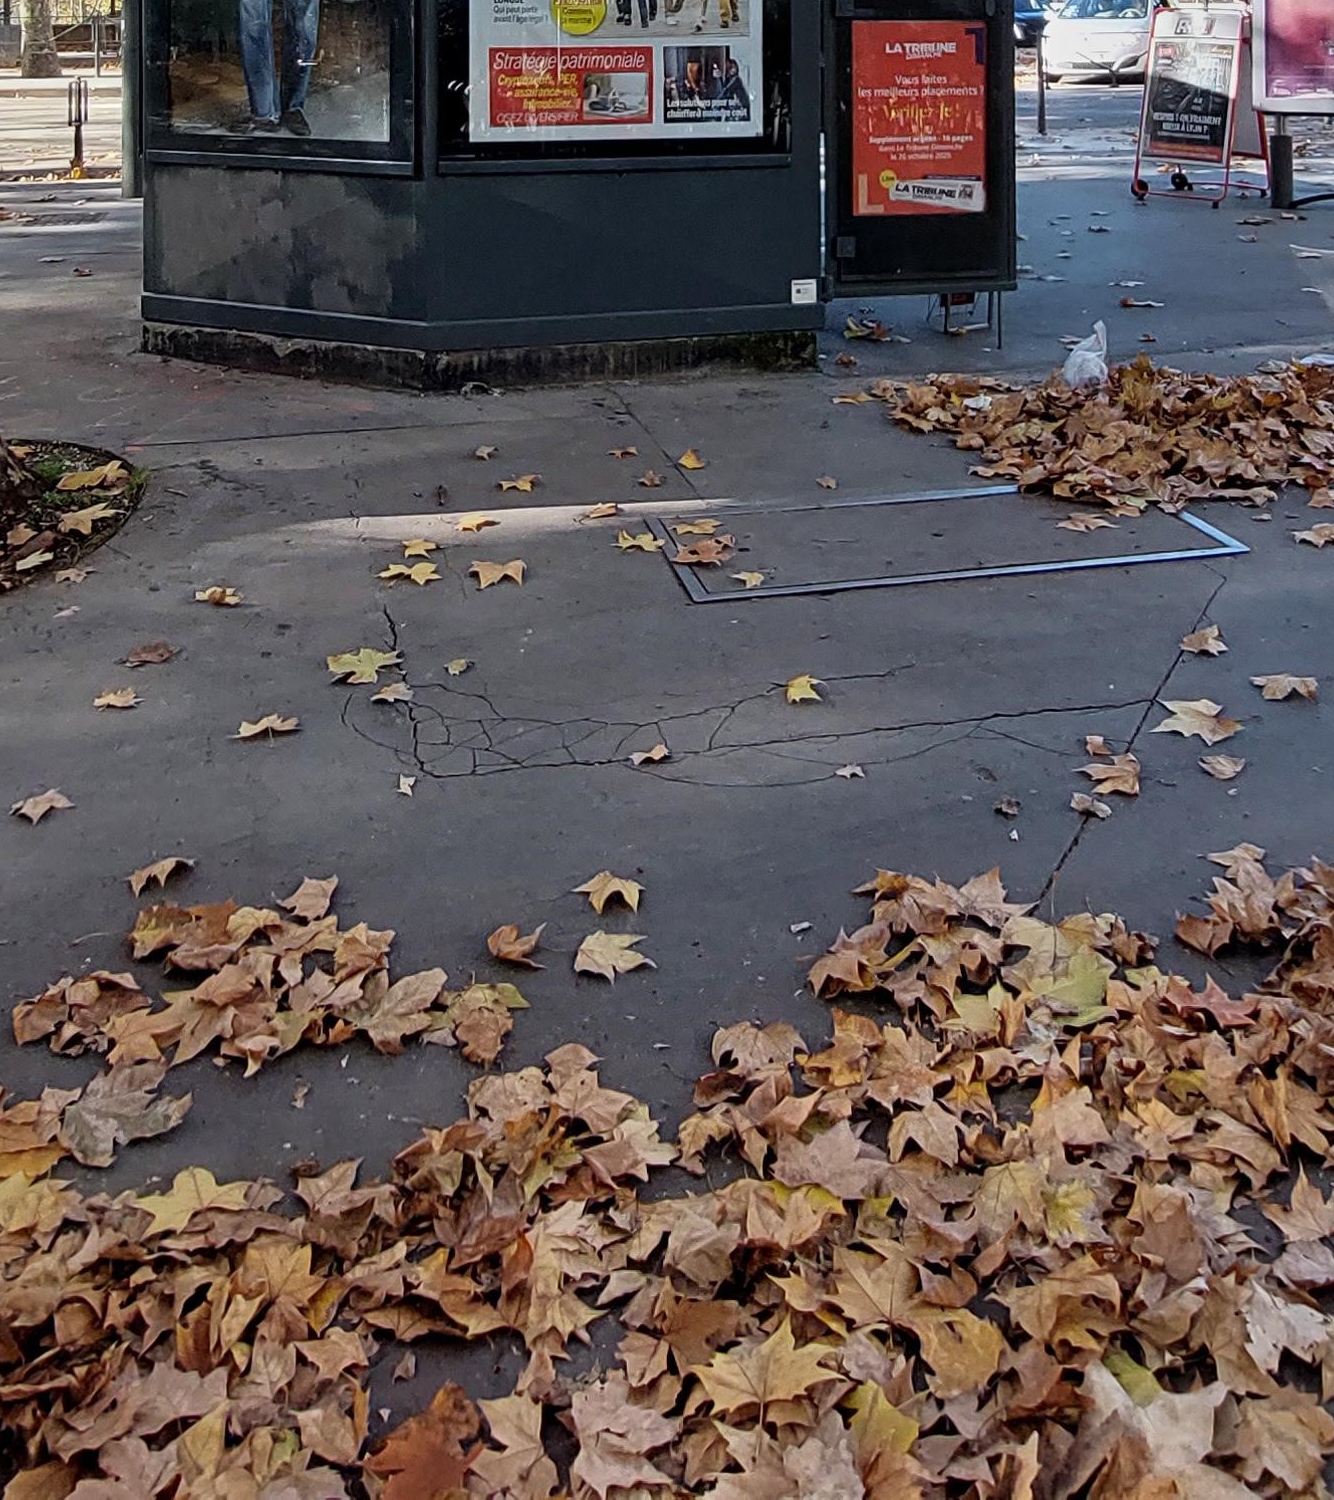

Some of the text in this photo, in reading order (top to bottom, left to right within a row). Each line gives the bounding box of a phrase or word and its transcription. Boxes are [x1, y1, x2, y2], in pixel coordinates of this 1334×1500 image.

[885, 41, 957, 53] LA TRIBUNE
[493, 51, 645, 73] Stratégie patrimoniale
[895, 74, 947, 85] Vous faites
[858, 87, 872, 97] les
[874, 86, 919, 97] meilleurs
[921, 85, 978, 98] placements
[895, 183, 957, 199] LA TRIBUNE
